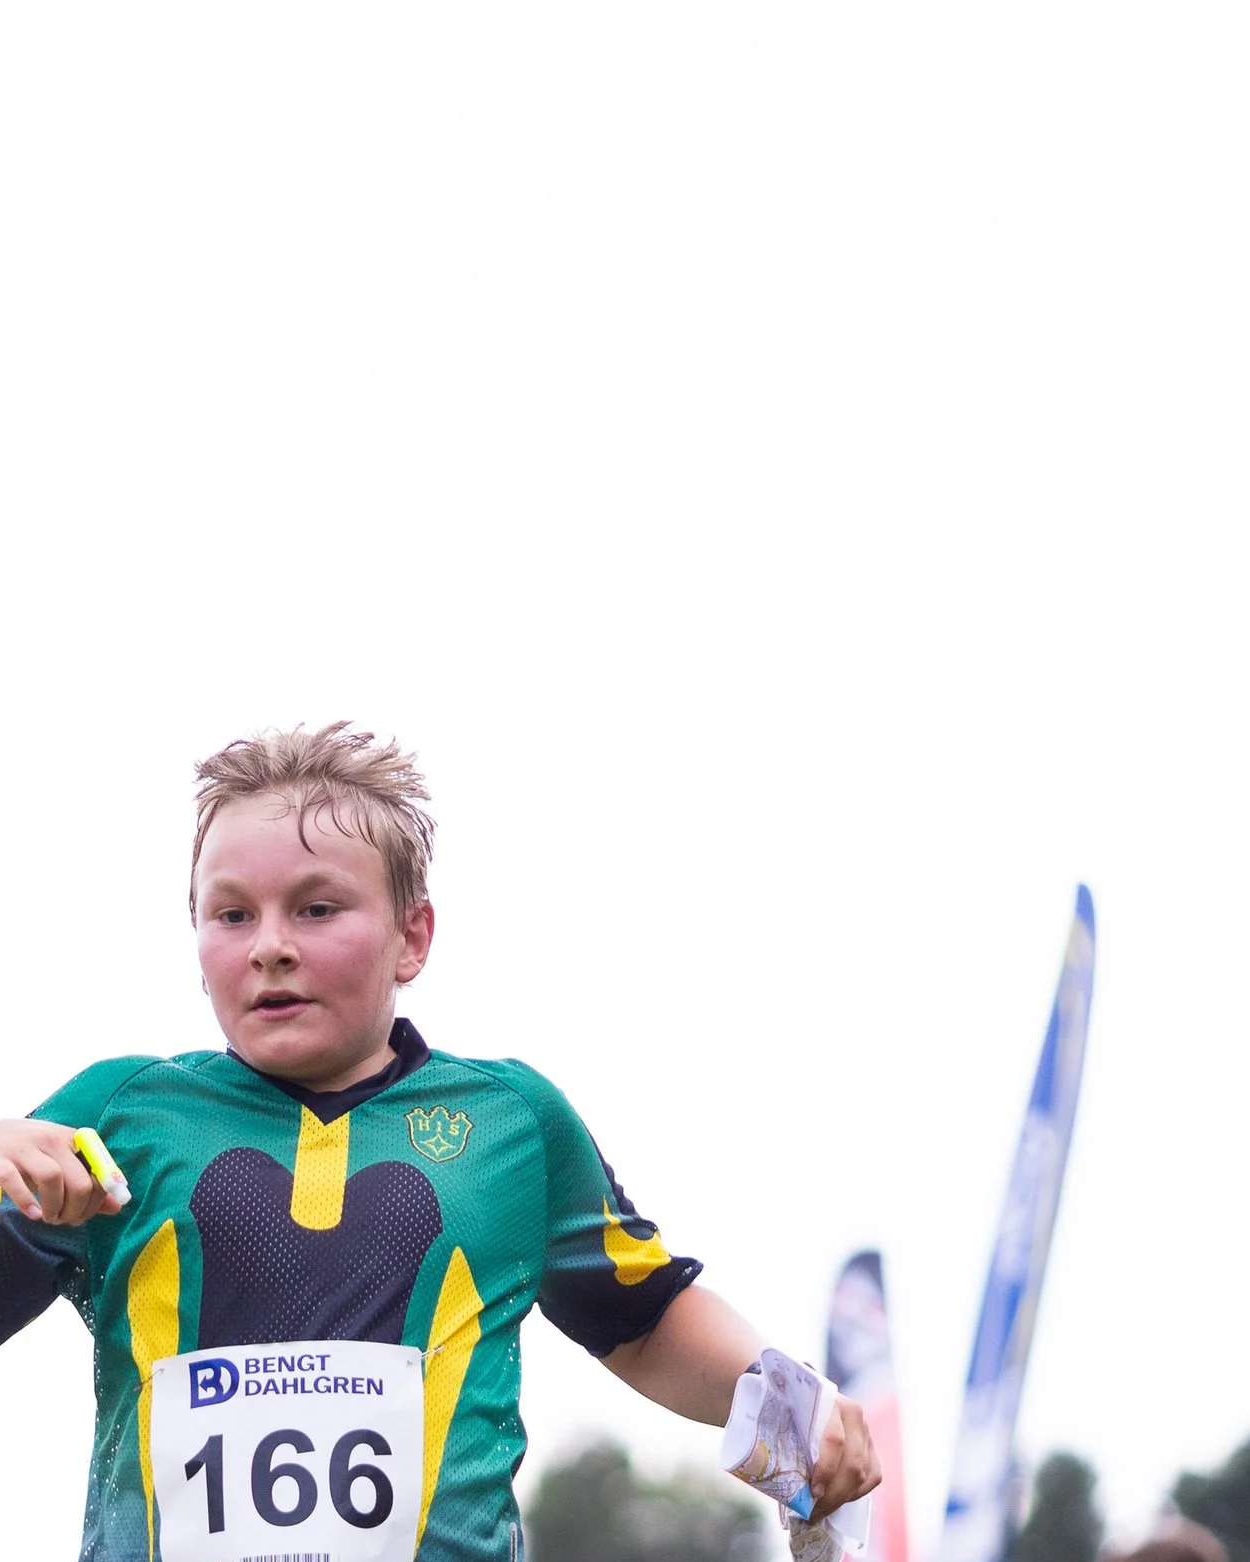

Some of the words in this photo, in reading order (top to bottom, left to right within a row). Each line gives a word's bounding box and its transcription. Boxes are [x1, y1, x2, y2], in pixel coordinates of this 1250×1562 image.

[245, 1354, 331, 1374] BENGT
[245, 1376, 384, 1396] DAHLGREN
[184, 1428, 394, 1534] 166
